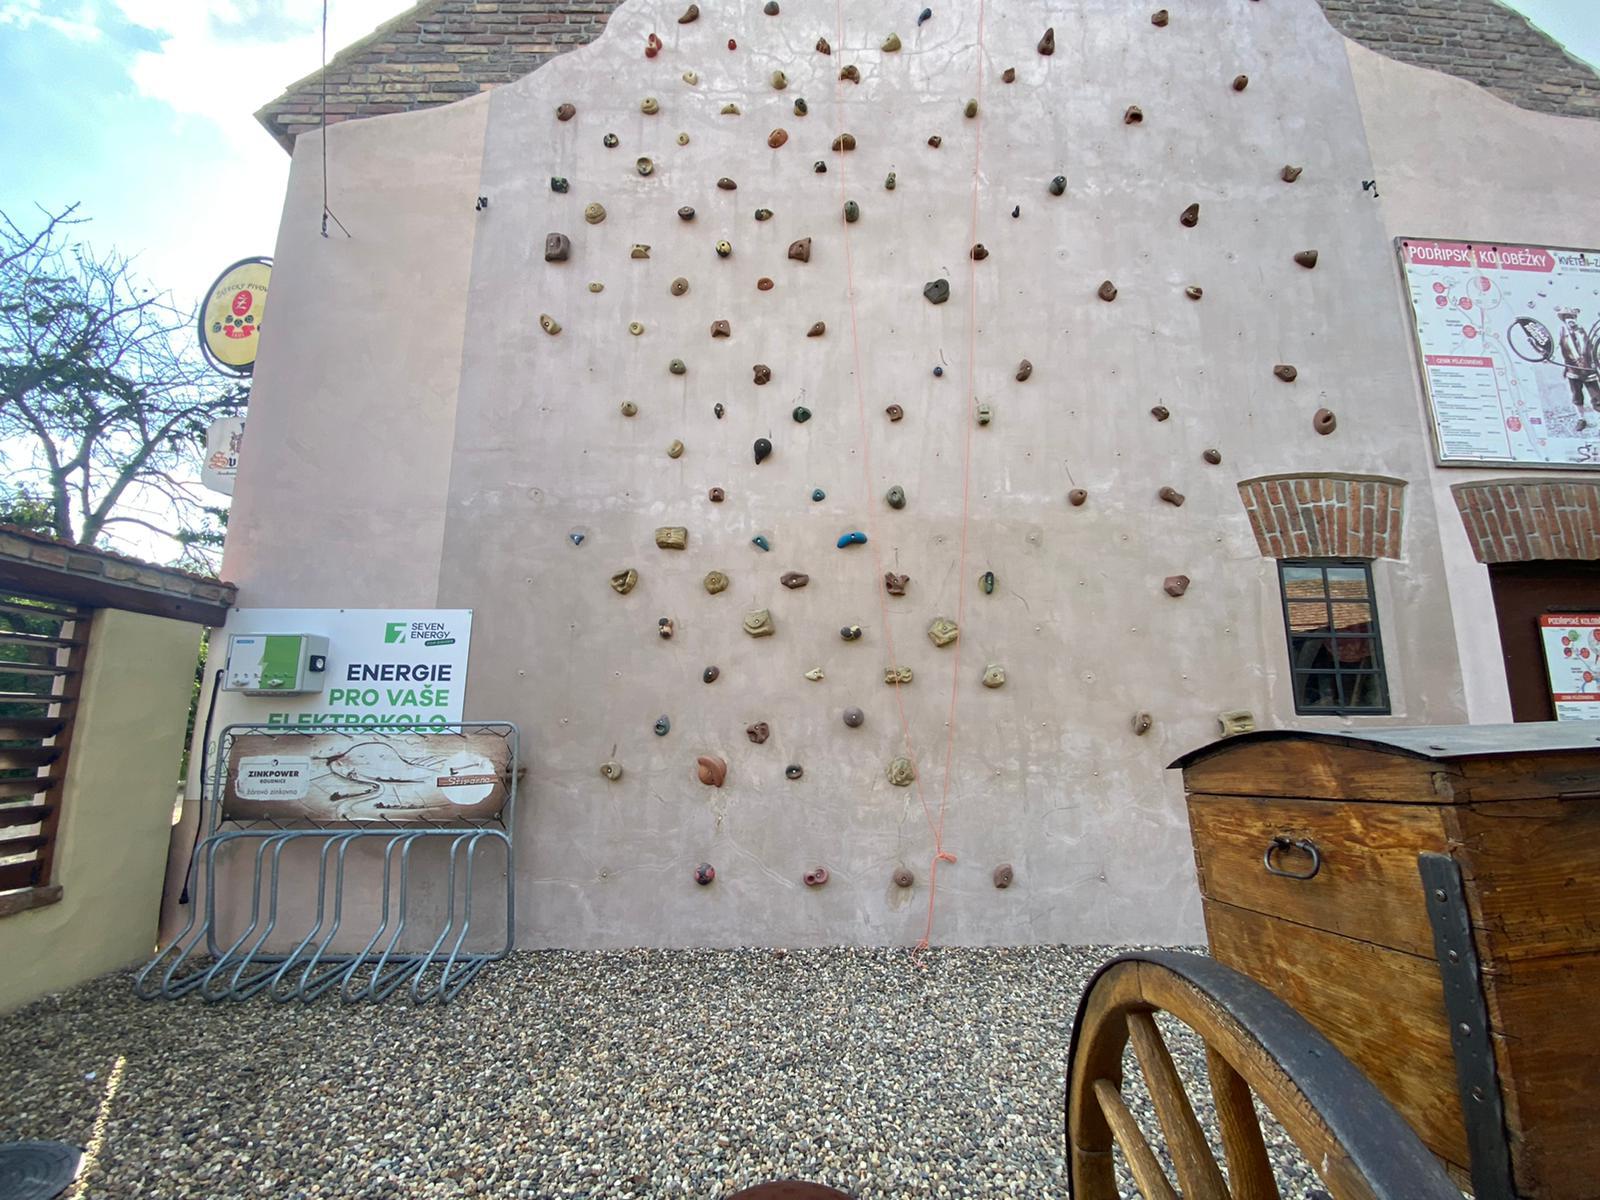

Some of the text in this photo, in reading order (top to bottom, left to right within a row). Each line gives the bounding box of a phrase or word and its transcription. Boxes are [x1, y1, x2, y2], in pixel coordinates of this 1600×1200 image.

[1409, 243, 1476, 262] PODŘIPSK
[410, 631, 451, 640] ENERGY
[411, 622, 445, 631] SEVEN
[347, 664, 453, 682] ENERGIE
[328, 684, 450, 707] PRO VAŠE
[267, 713, 448, 732] ELEKTROKOLO
